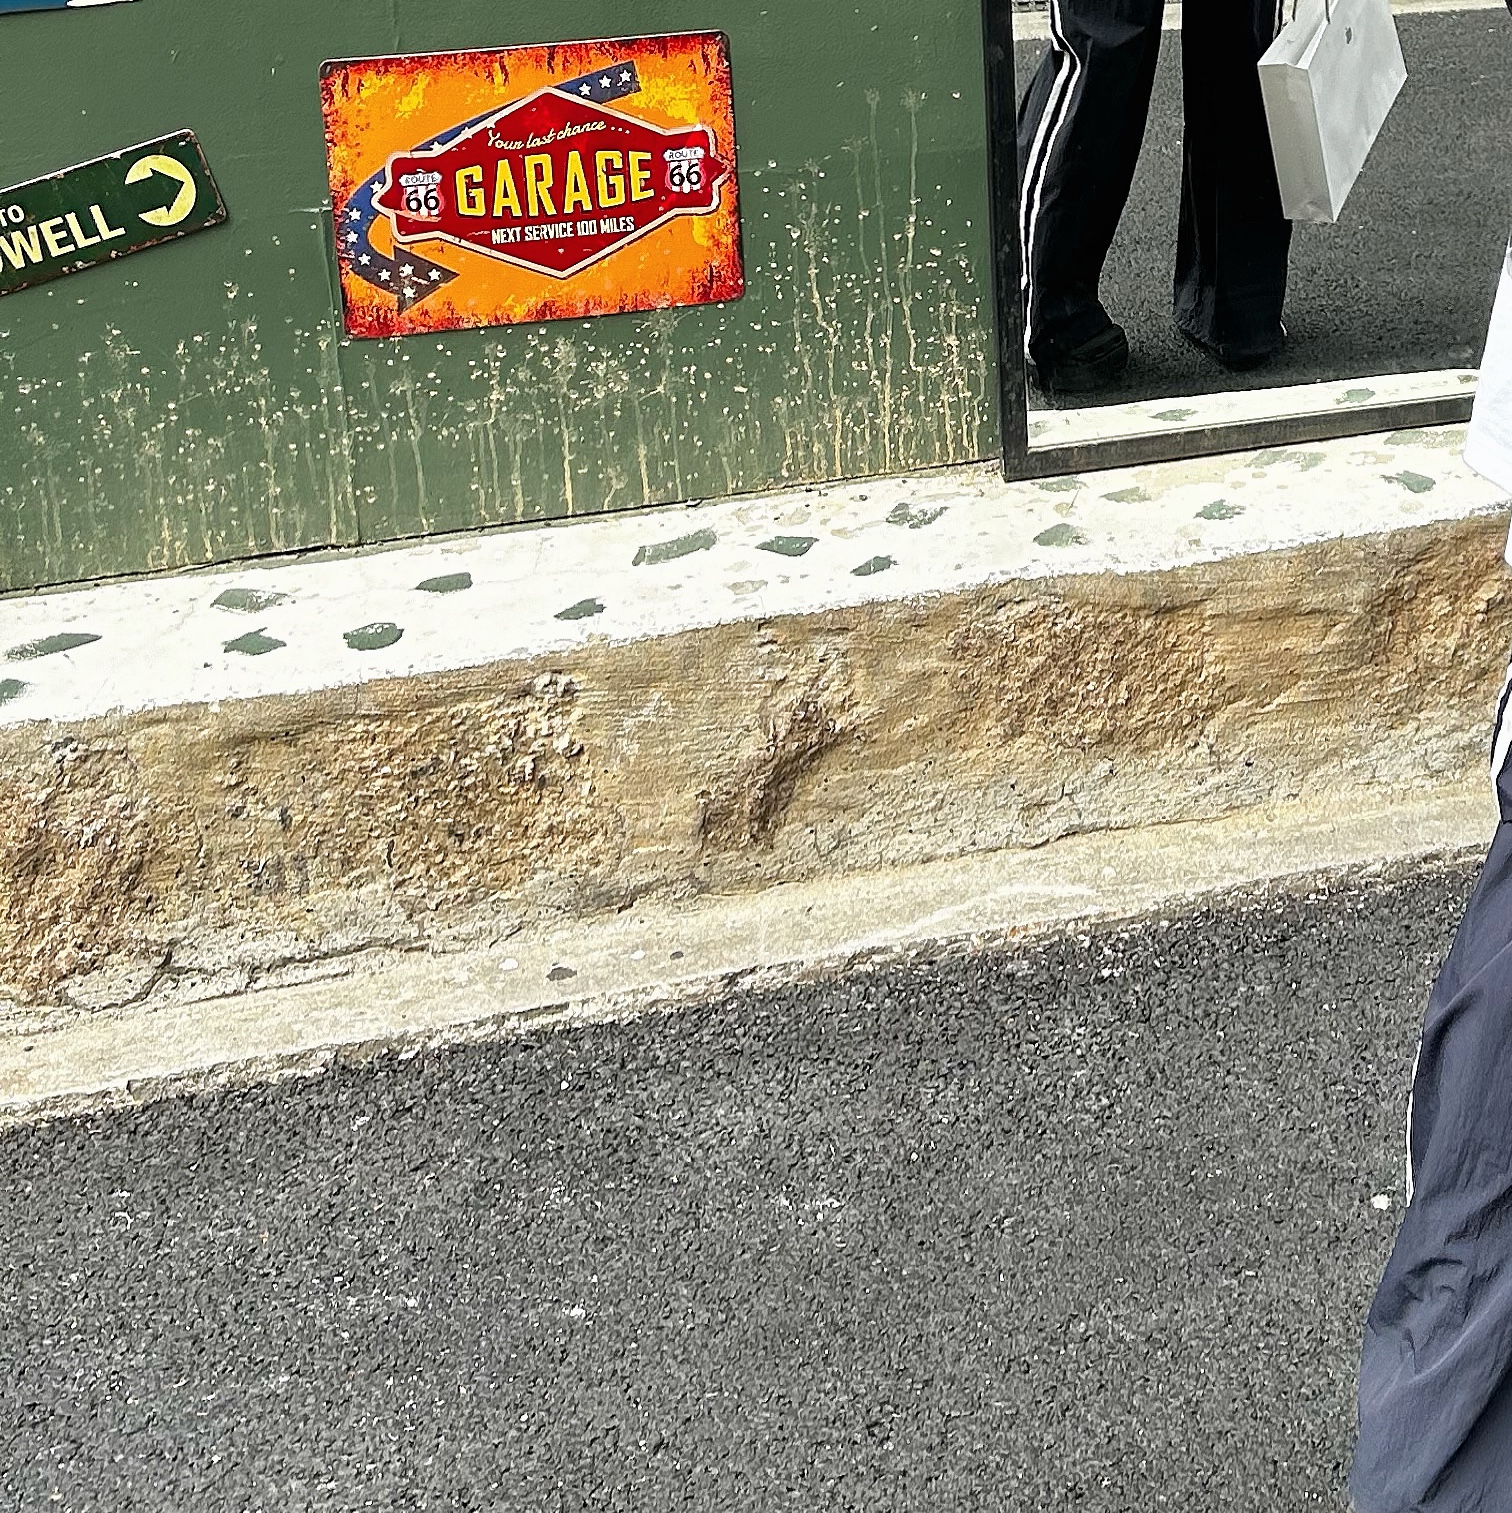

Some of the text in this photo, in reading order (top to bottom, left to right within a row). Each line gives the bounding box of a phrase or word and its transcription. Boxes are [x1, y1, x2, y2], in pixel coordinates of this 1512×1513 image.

[486, 129, 525, 150] Your
[525, 128, 556, 149] last
[454, 149, 656, 218] GARAGE
[669, 163, 702, 192] 66
[405, 188, 441, 215] 66
[0, 204, 127, 273] WELL
[491, 216, 636, 245] NEXT SERVICE 100 MILES
